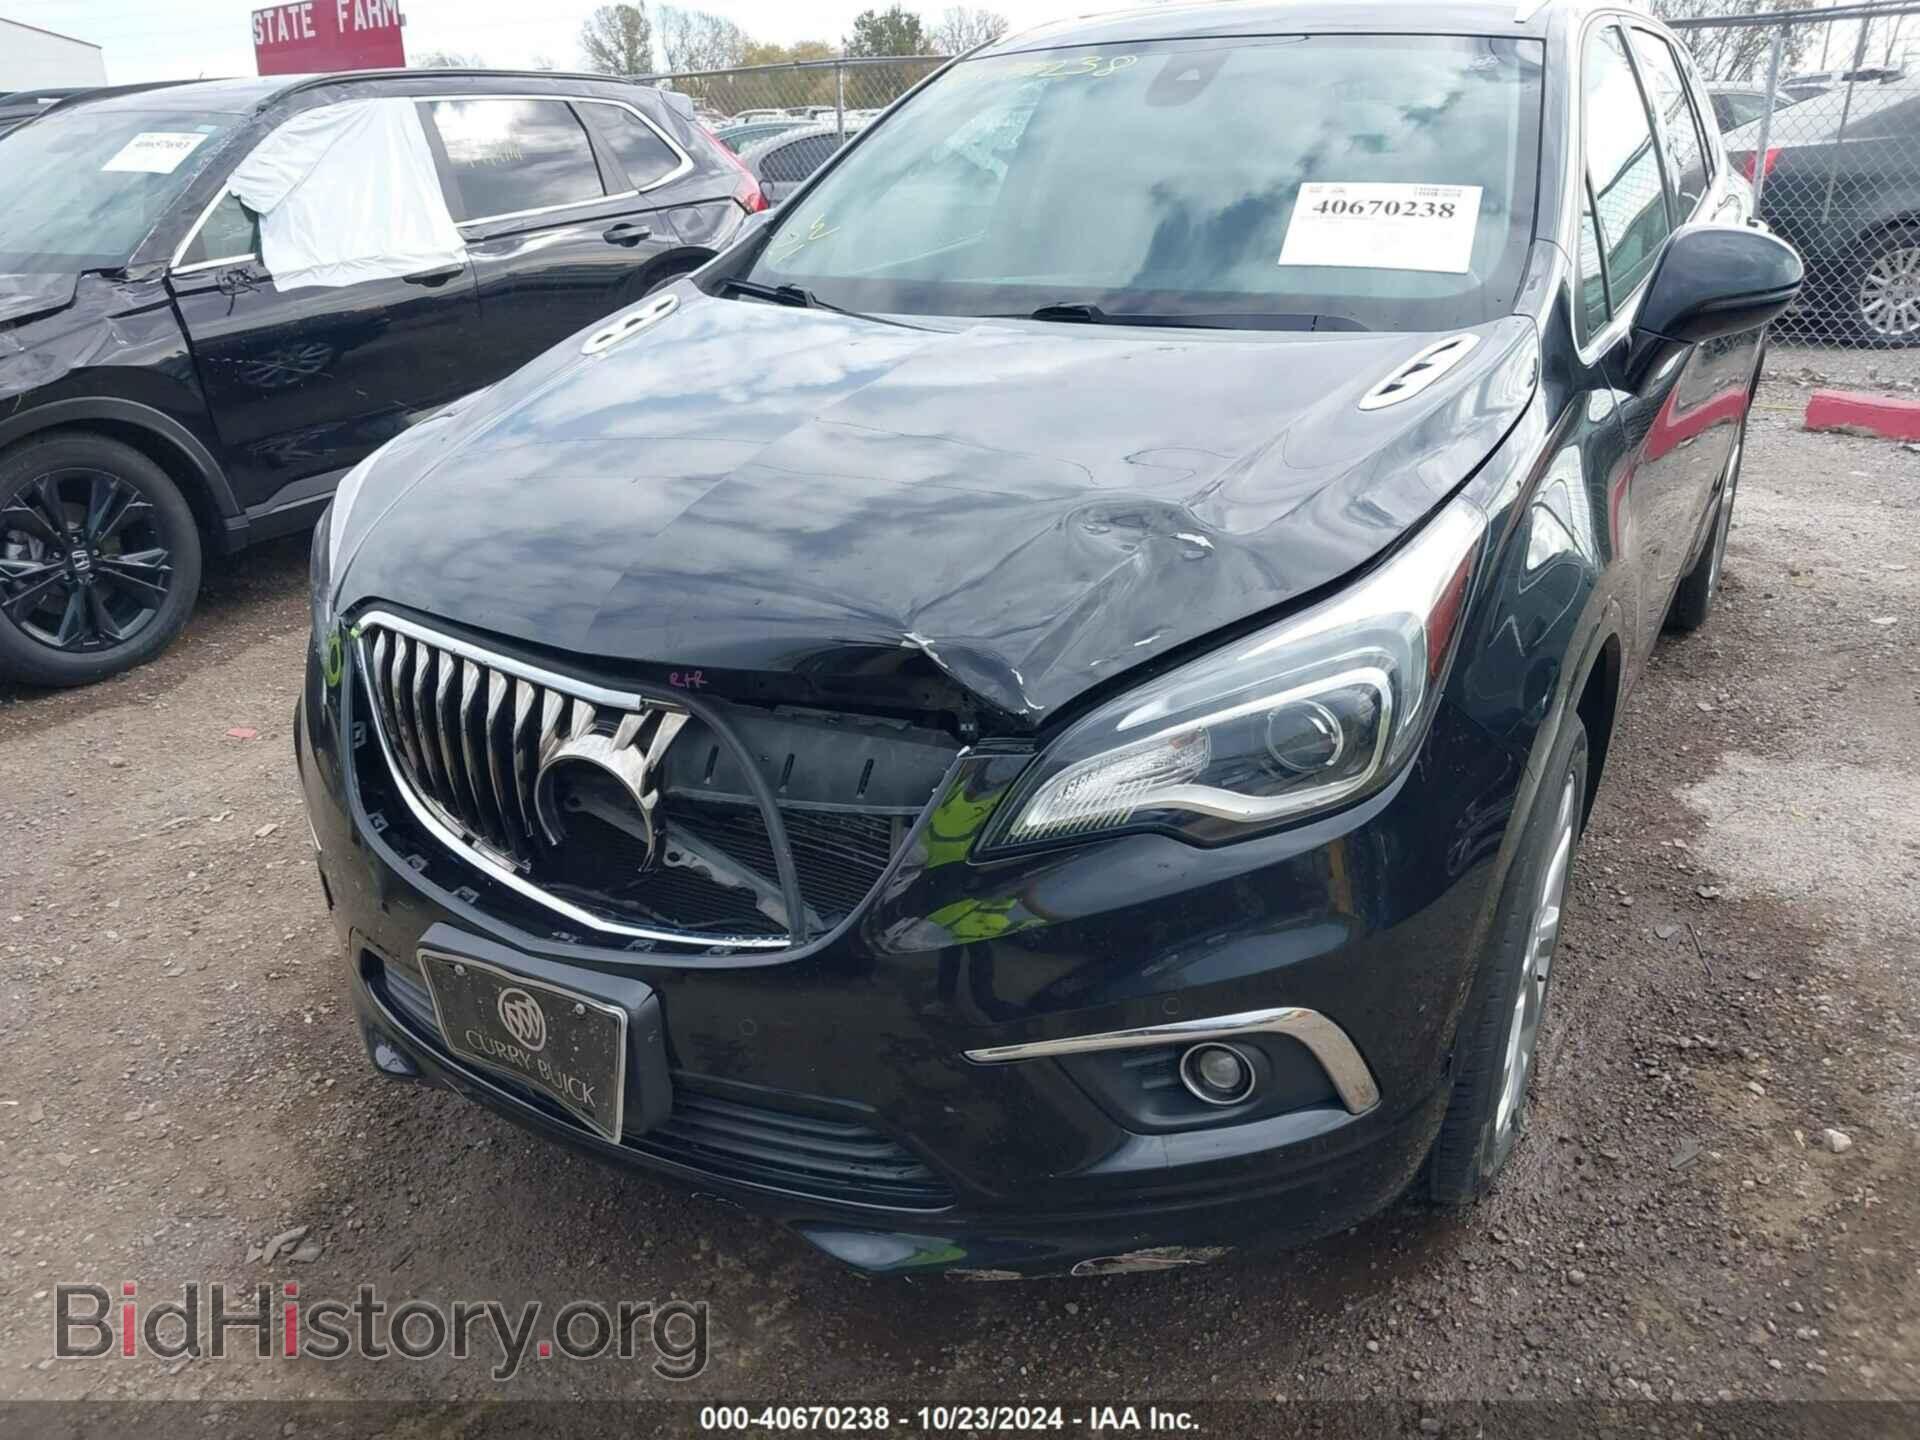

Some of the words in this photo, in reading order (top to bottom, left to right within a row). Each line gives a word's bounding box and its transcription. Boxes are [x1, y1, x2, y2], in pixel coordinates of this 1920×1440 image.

[252, 3, 316, 45] STATE
[337, 0, 399, 33] FARM
[1312, 199, 1456, 219] 40670238
[465, 1030, 531, 1070] CURRY
[537, 1058, 596, 1108] BUICK
